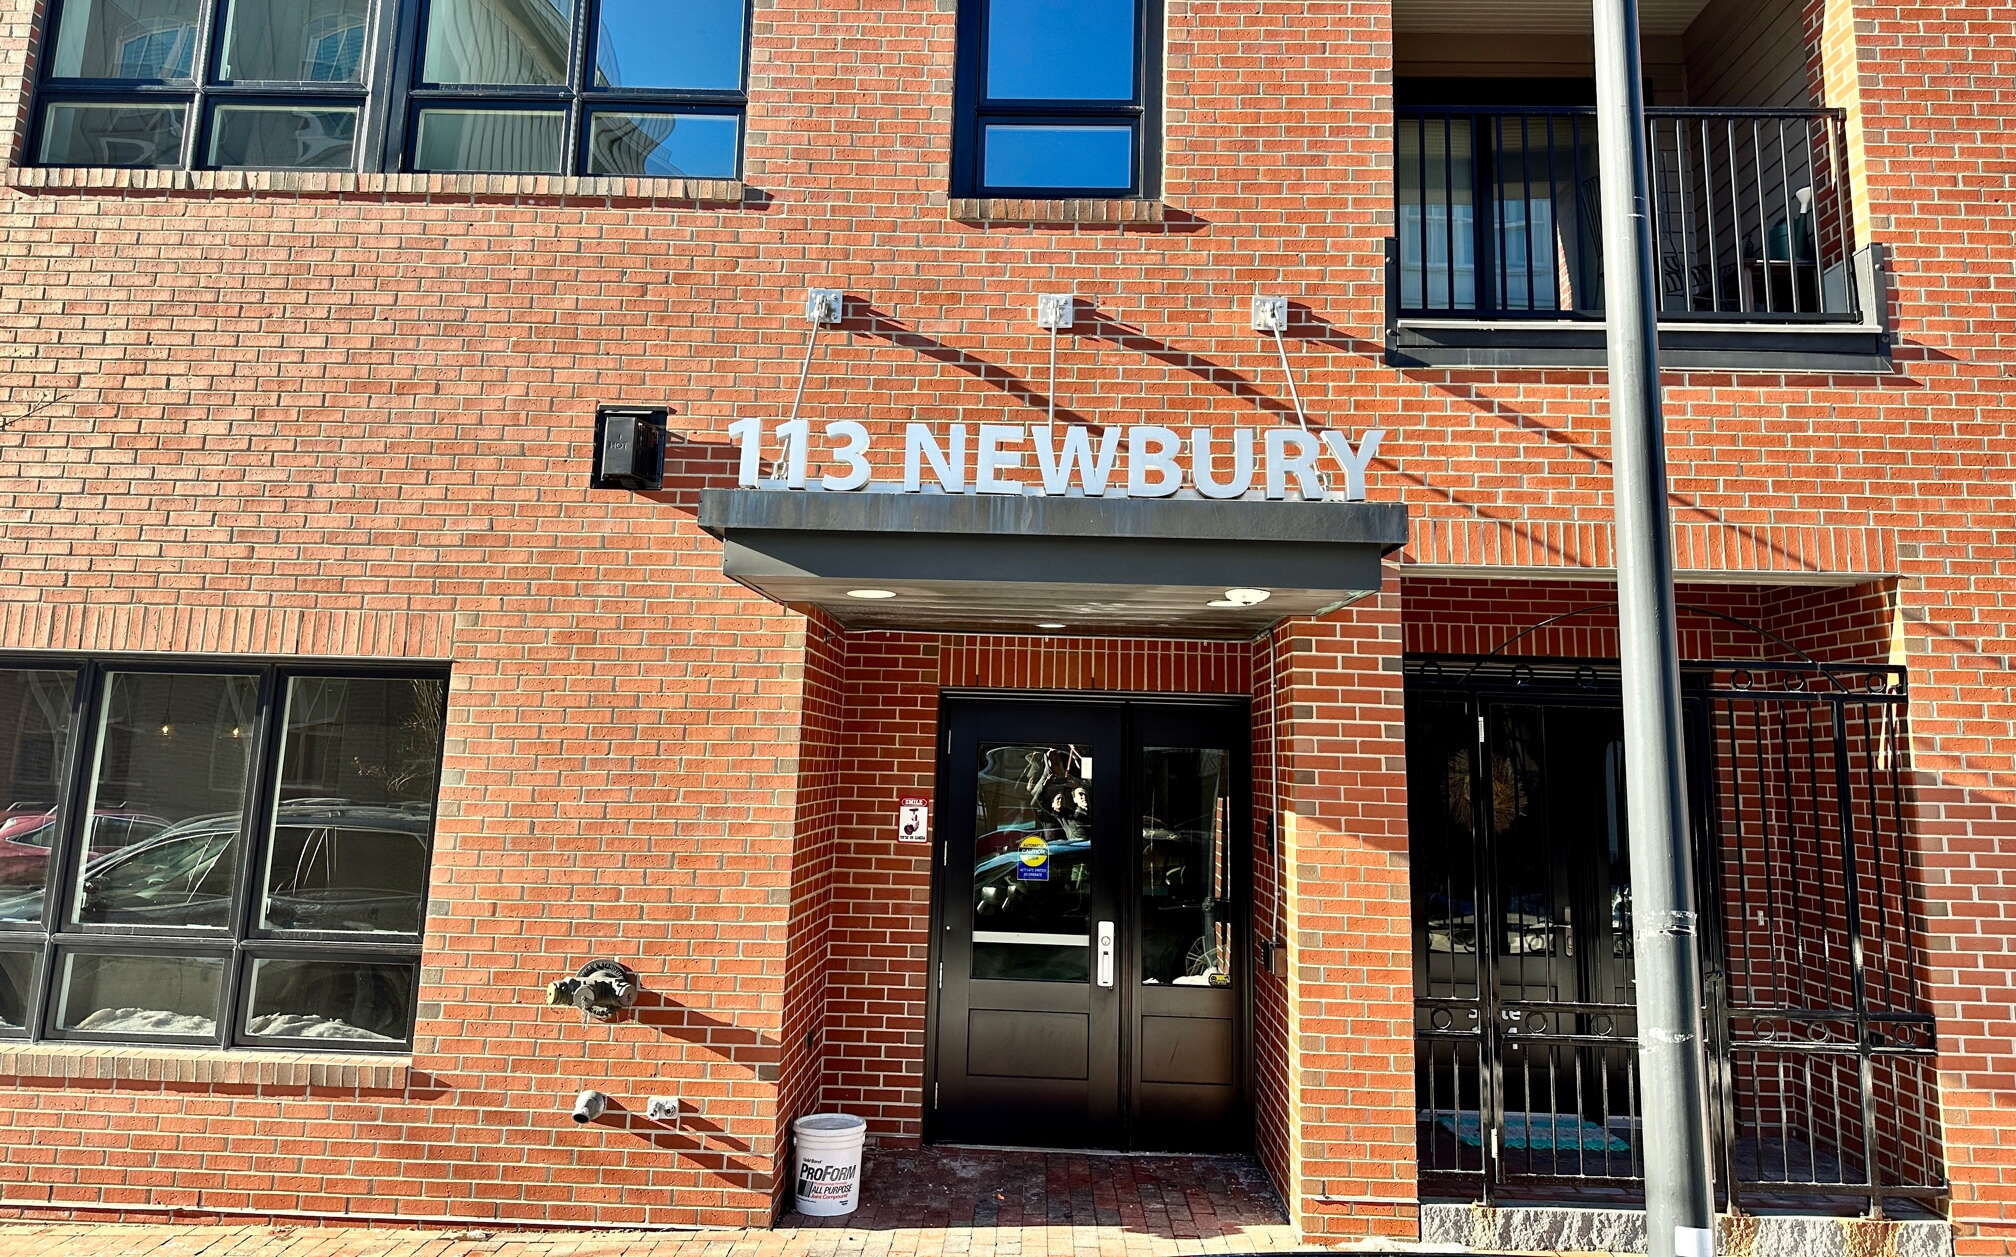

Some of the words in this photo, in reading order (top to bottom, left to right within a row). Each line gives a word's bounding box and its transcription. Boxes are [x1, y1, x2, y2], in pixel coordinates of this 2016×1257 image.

[728, 417, 871, 491] 113
[903, 422, 1386, 501] NEWBURY
[811, 1185, 823, 1194] ALL
[824, 1184, 853, 1195] PURPOSE
